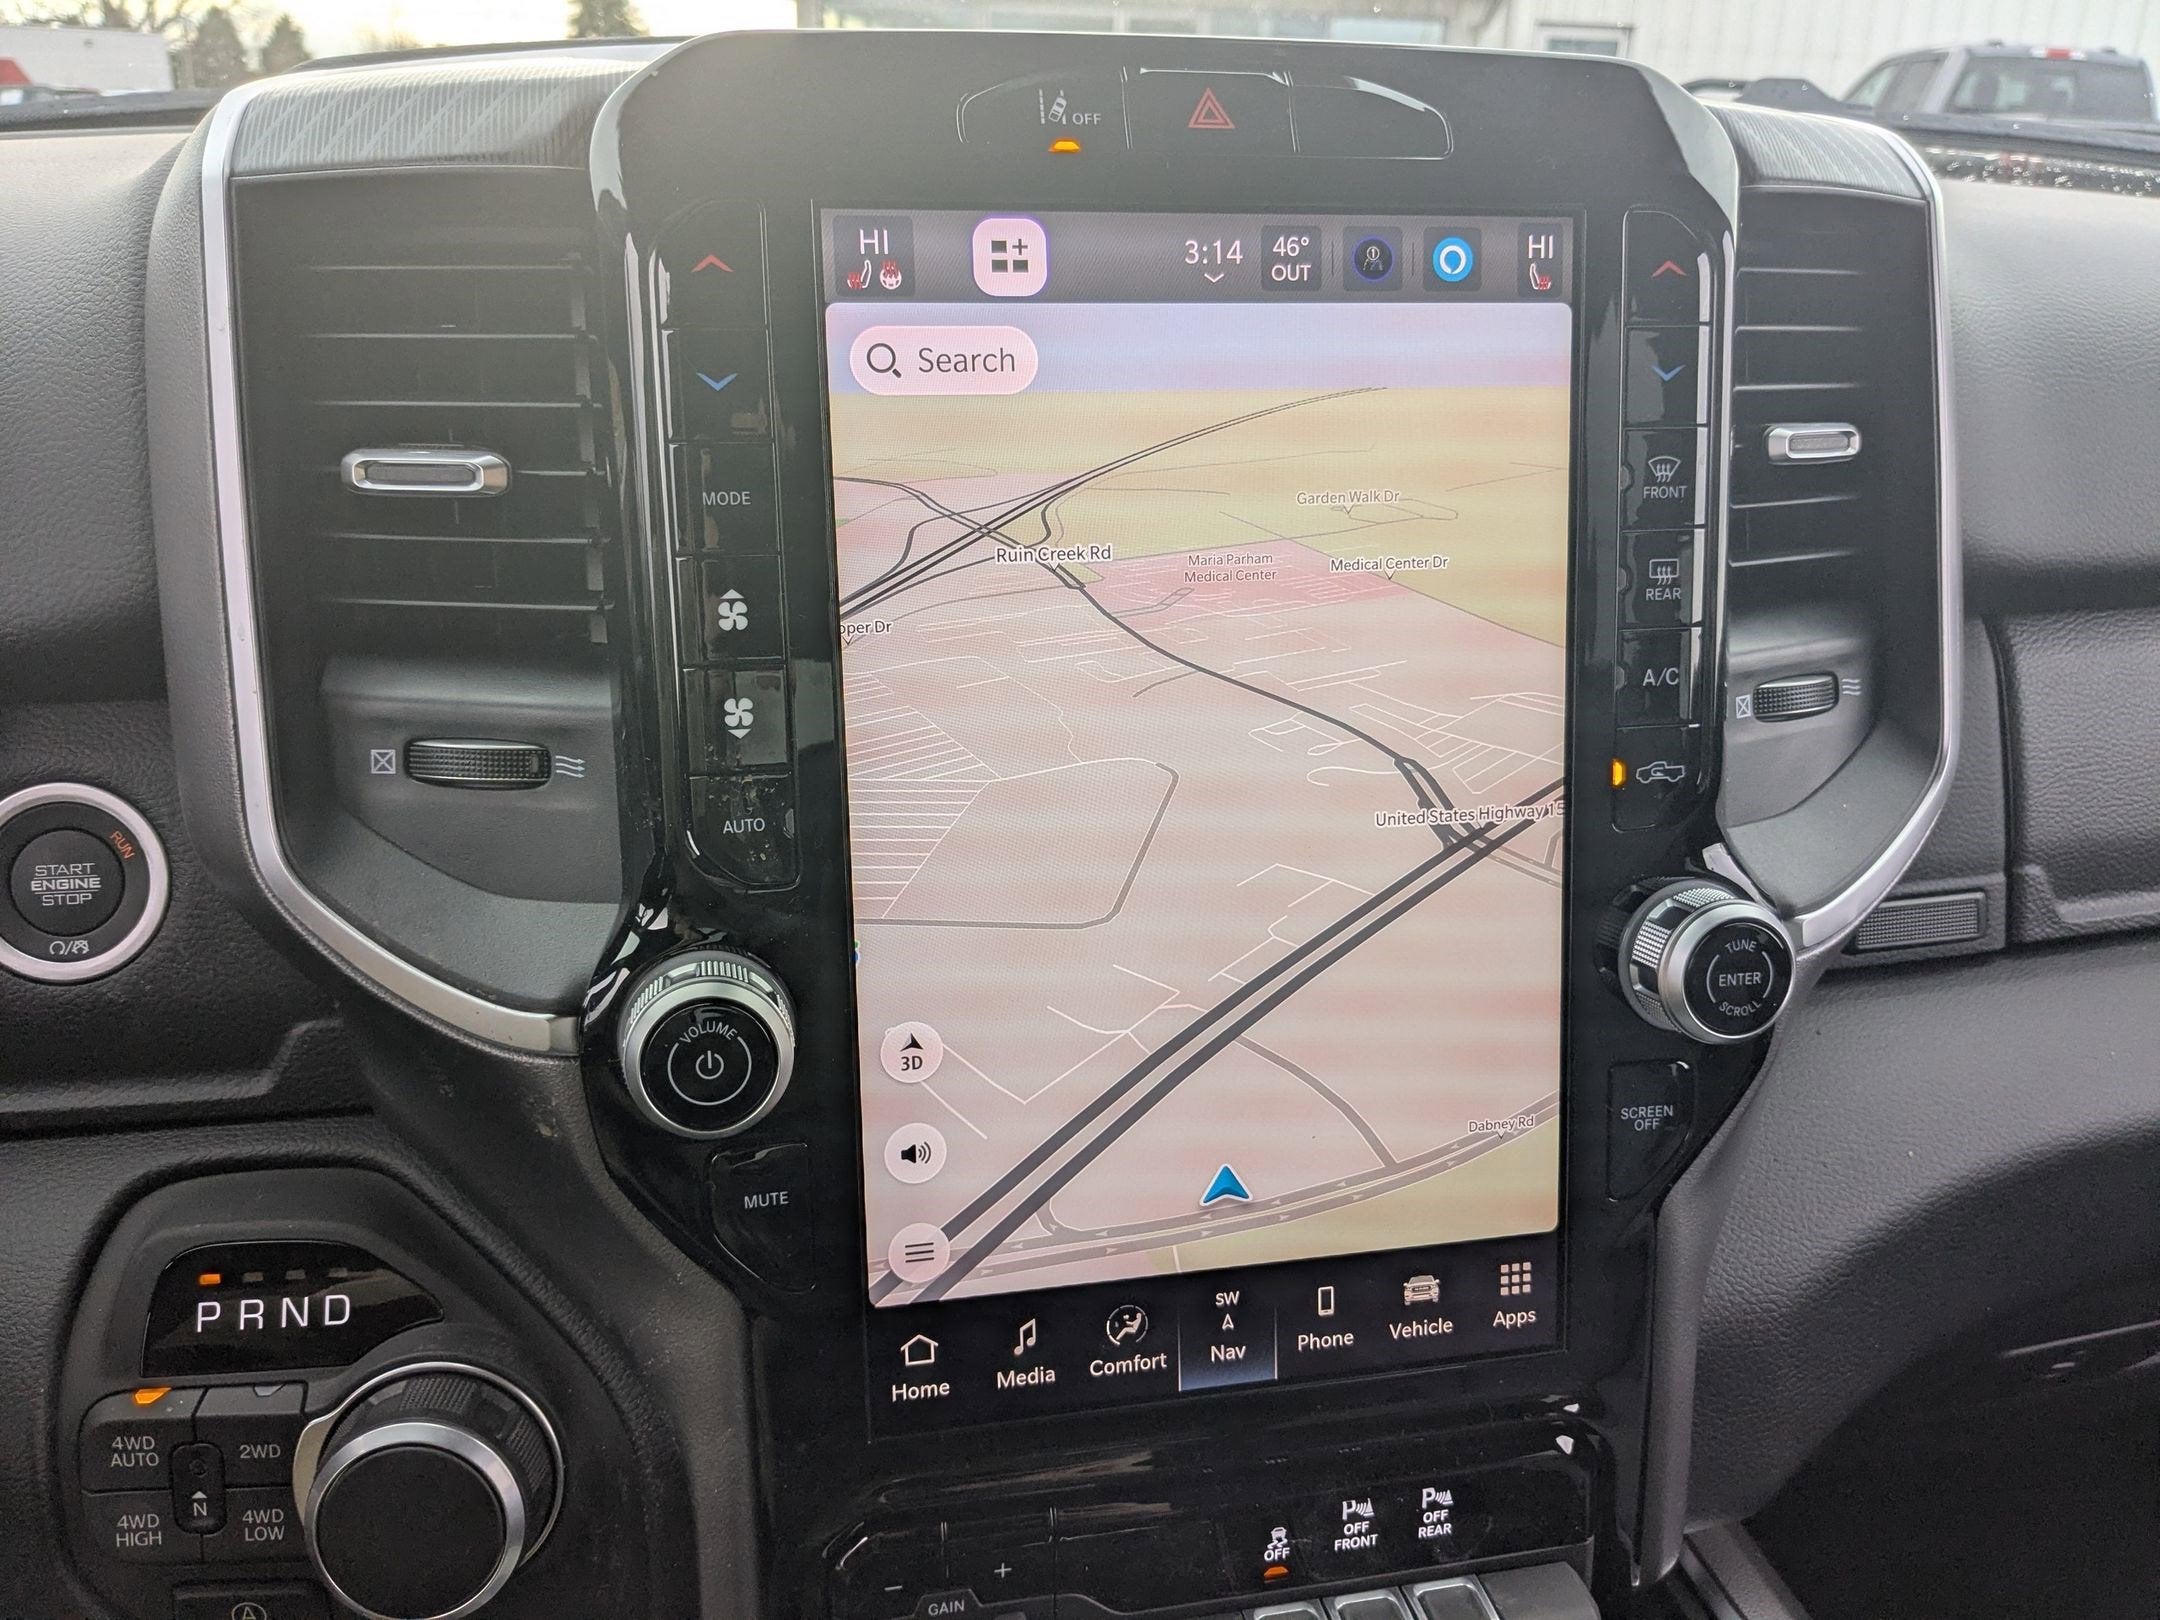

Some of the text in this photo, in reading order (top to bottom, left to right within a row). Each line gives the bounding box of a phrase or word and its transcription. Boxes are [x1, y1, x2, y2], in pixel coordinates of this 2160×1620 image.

[1072, 112, 1102, 125] OFF
[858, 229, 891, 255] HI
[1527, 234, 1554, 260] HI
[1184, 239, 1244, 266] 3:14
[1271, 264, 1311, 283] OUT
[918, 345, 1017, 375] Search
[702, 490, 752, 506] MODE
[1297, 490, 1400, 505] Garden Walk Dr
[1643, 485, 1688, 499] FRONT
[996, 544, 1112, 563] Ruin Creek Rd
[1188, 553, 1273, 566] Maria Parham
[1330, 555, 1449, 572] Medical Center Dr
[1184, 570, 1277, 583] Medical Center
[1646, 588, 1681, 601] REAR
[875, 620, 892, 633] Dr
[1642, 668, 1679, 686] A/C
[1375, 810, 1426, 827] United
[1429, 807, 1475, 823] States
[1479, 803, 1544, 821] Highway
[723, 818, 766, 834] AUTO
[110, 830, 135, 860] RUN
[35, 863, 96, 876] START
[31, 878, 102, 891] ENGINE
[42, 893, 92, 906] STOP
[1724, 938, 1757, 953] TUNE
[1718, 972, 1761, 987] ENTER
[1718, 1000, 1762, 1017] SCROLL
[680, 1020, 738, 1044] VOLUME
[900, 1055, 924, 1072] 3D
[1620, 1104, 1674, 1119] SCREEN
[1469, 1116, 1534, 1132] Dabney Rd
[1634, 1117, 1661, 1131] OFF
[744, 1192, 789, 1208] MUTE
[1215, 1290, 1239, 1305] SW
[196, 1294, 350, 1333] P R N D
[1492, 1309, 1537, 1330] Apps
[1389, 1317, 1454, 1339] Vehicle
[1298, 1331, 1354, 1352] Phone
[1210, 1345, 1247, 1363] Nav
[1089, 1352, 1168, 1378] Comfort
[997, 1367, 1056, 1390] Media
[891, 1381, 950, 1402] Home
[112, 1436, 155, 1450] 4WD
[240, 1444, 281, 1458] 2WD
[111, 1452, 159, 1467] AUTO
[193, 1502, 208, 1516] N
[242, 1509, 284, 1524] 4WD
[1422, 1509, 1449, 1523] OFF
[117, 1514, 160, 1529] 4WD
[1343, 1521, 1370, 1535] OFF
[116, 1531, 162, 1547] HIGH
[244, 1525, 285, 1541] LOW
[1418, 1523, 1452, 1539] REAR
[1334, 1534, 1378, 1551] FRONT
[1264, 1547, 1291, 1561] OFF
[928, 1600, 965, 1616] GAIN
